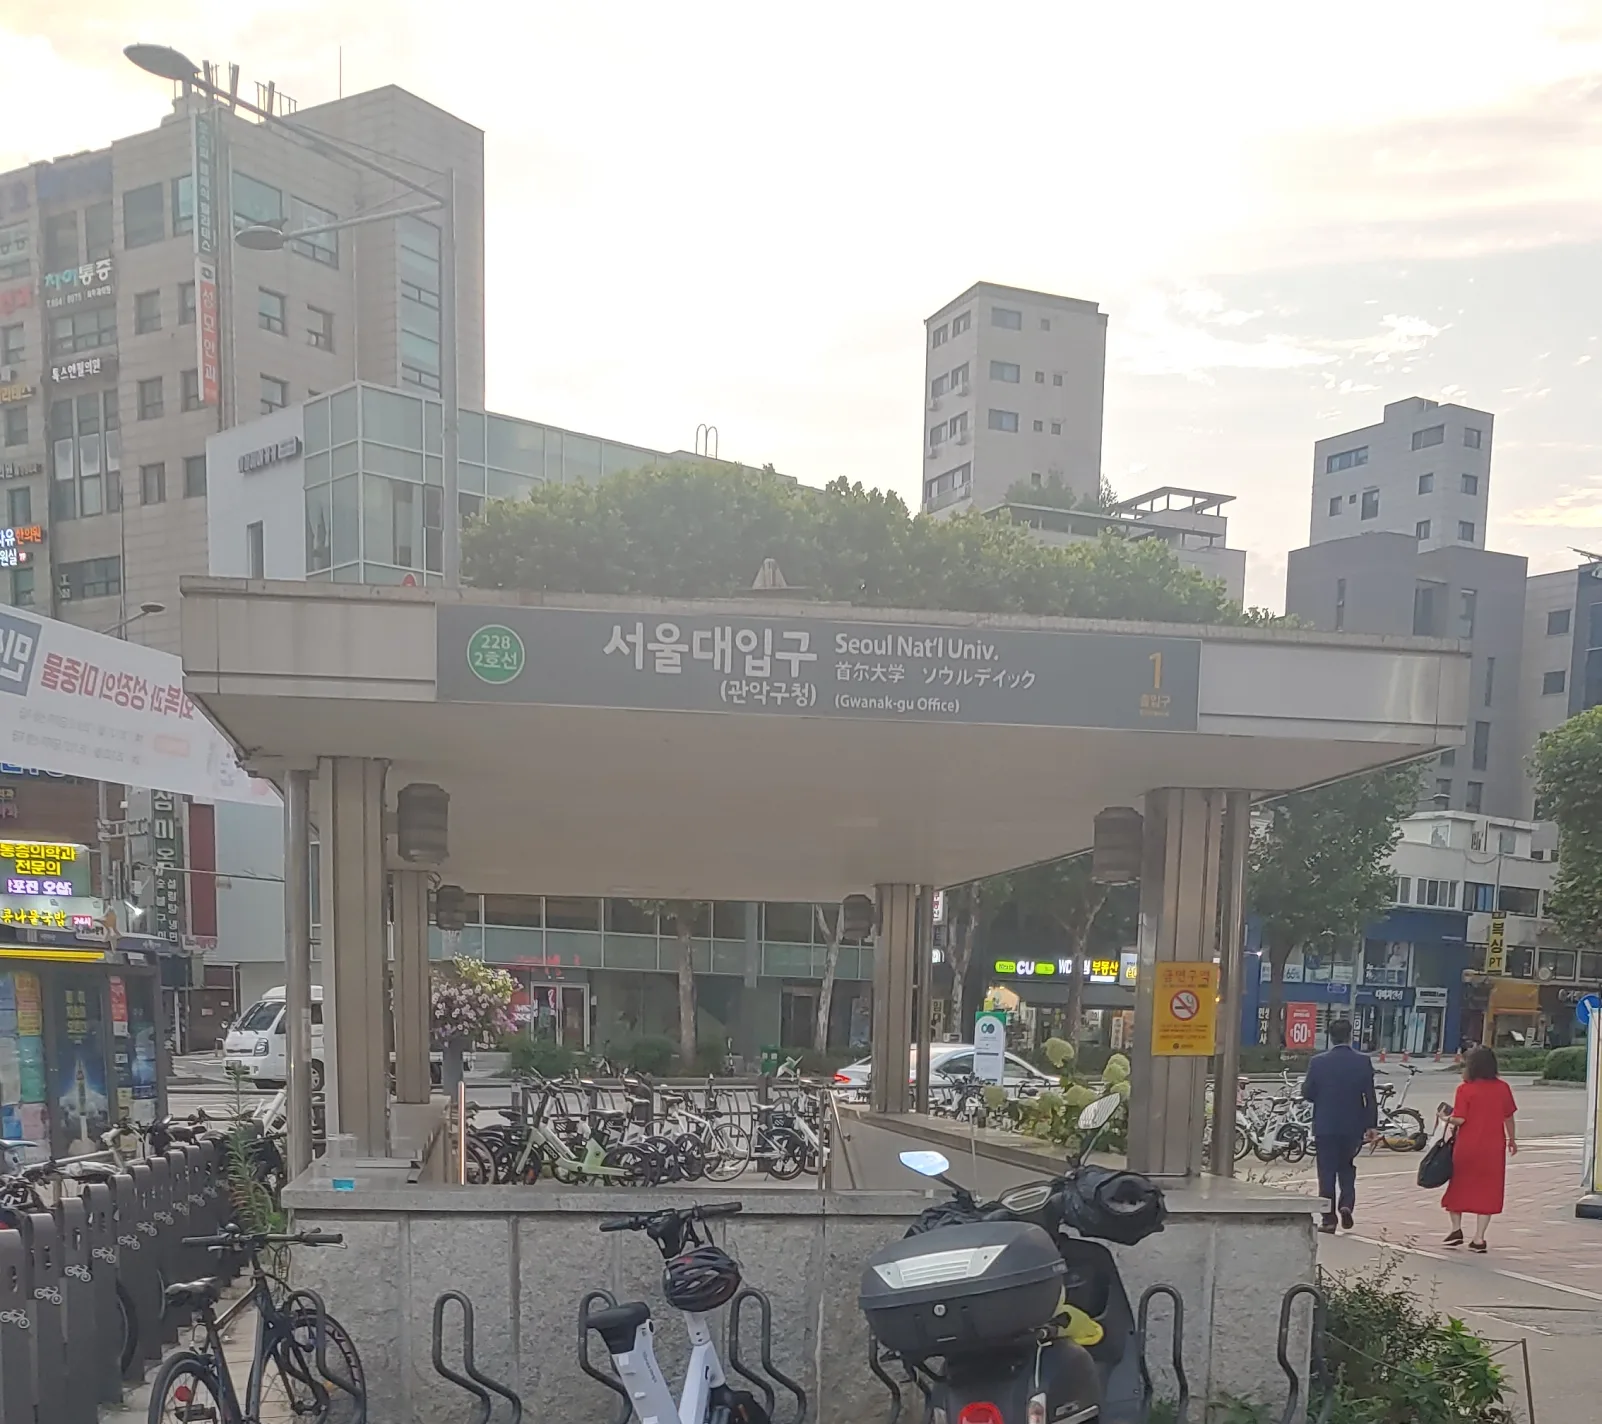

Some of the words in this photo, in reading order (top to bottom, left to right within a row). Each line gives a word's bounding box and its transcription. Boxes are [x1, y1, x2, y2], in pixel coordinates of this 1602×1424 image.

[481, 634, 511, 649] 228
[603, 622, 818, 678] 서울대입구
[835, 633, 893, 656] Seoul
[897, 636, 943, 658] Nat'l
[948, 639, 999, 661] Univ.
[474, 651, 518, 670] 2호선
[1149, 651, 1162, 689] 1
[720, 680, 817, 707] (관악구청)
[834, 694, 914, 713] (Gwanak-gu
[917, 697, 960, 713] Office)
[15, 860, 62, 876] 전문의
[1016, 960, 1035, 975] CU
[1092, 960, 1119, 976] 부동산
[1489, 957, 1502, 967] PT
